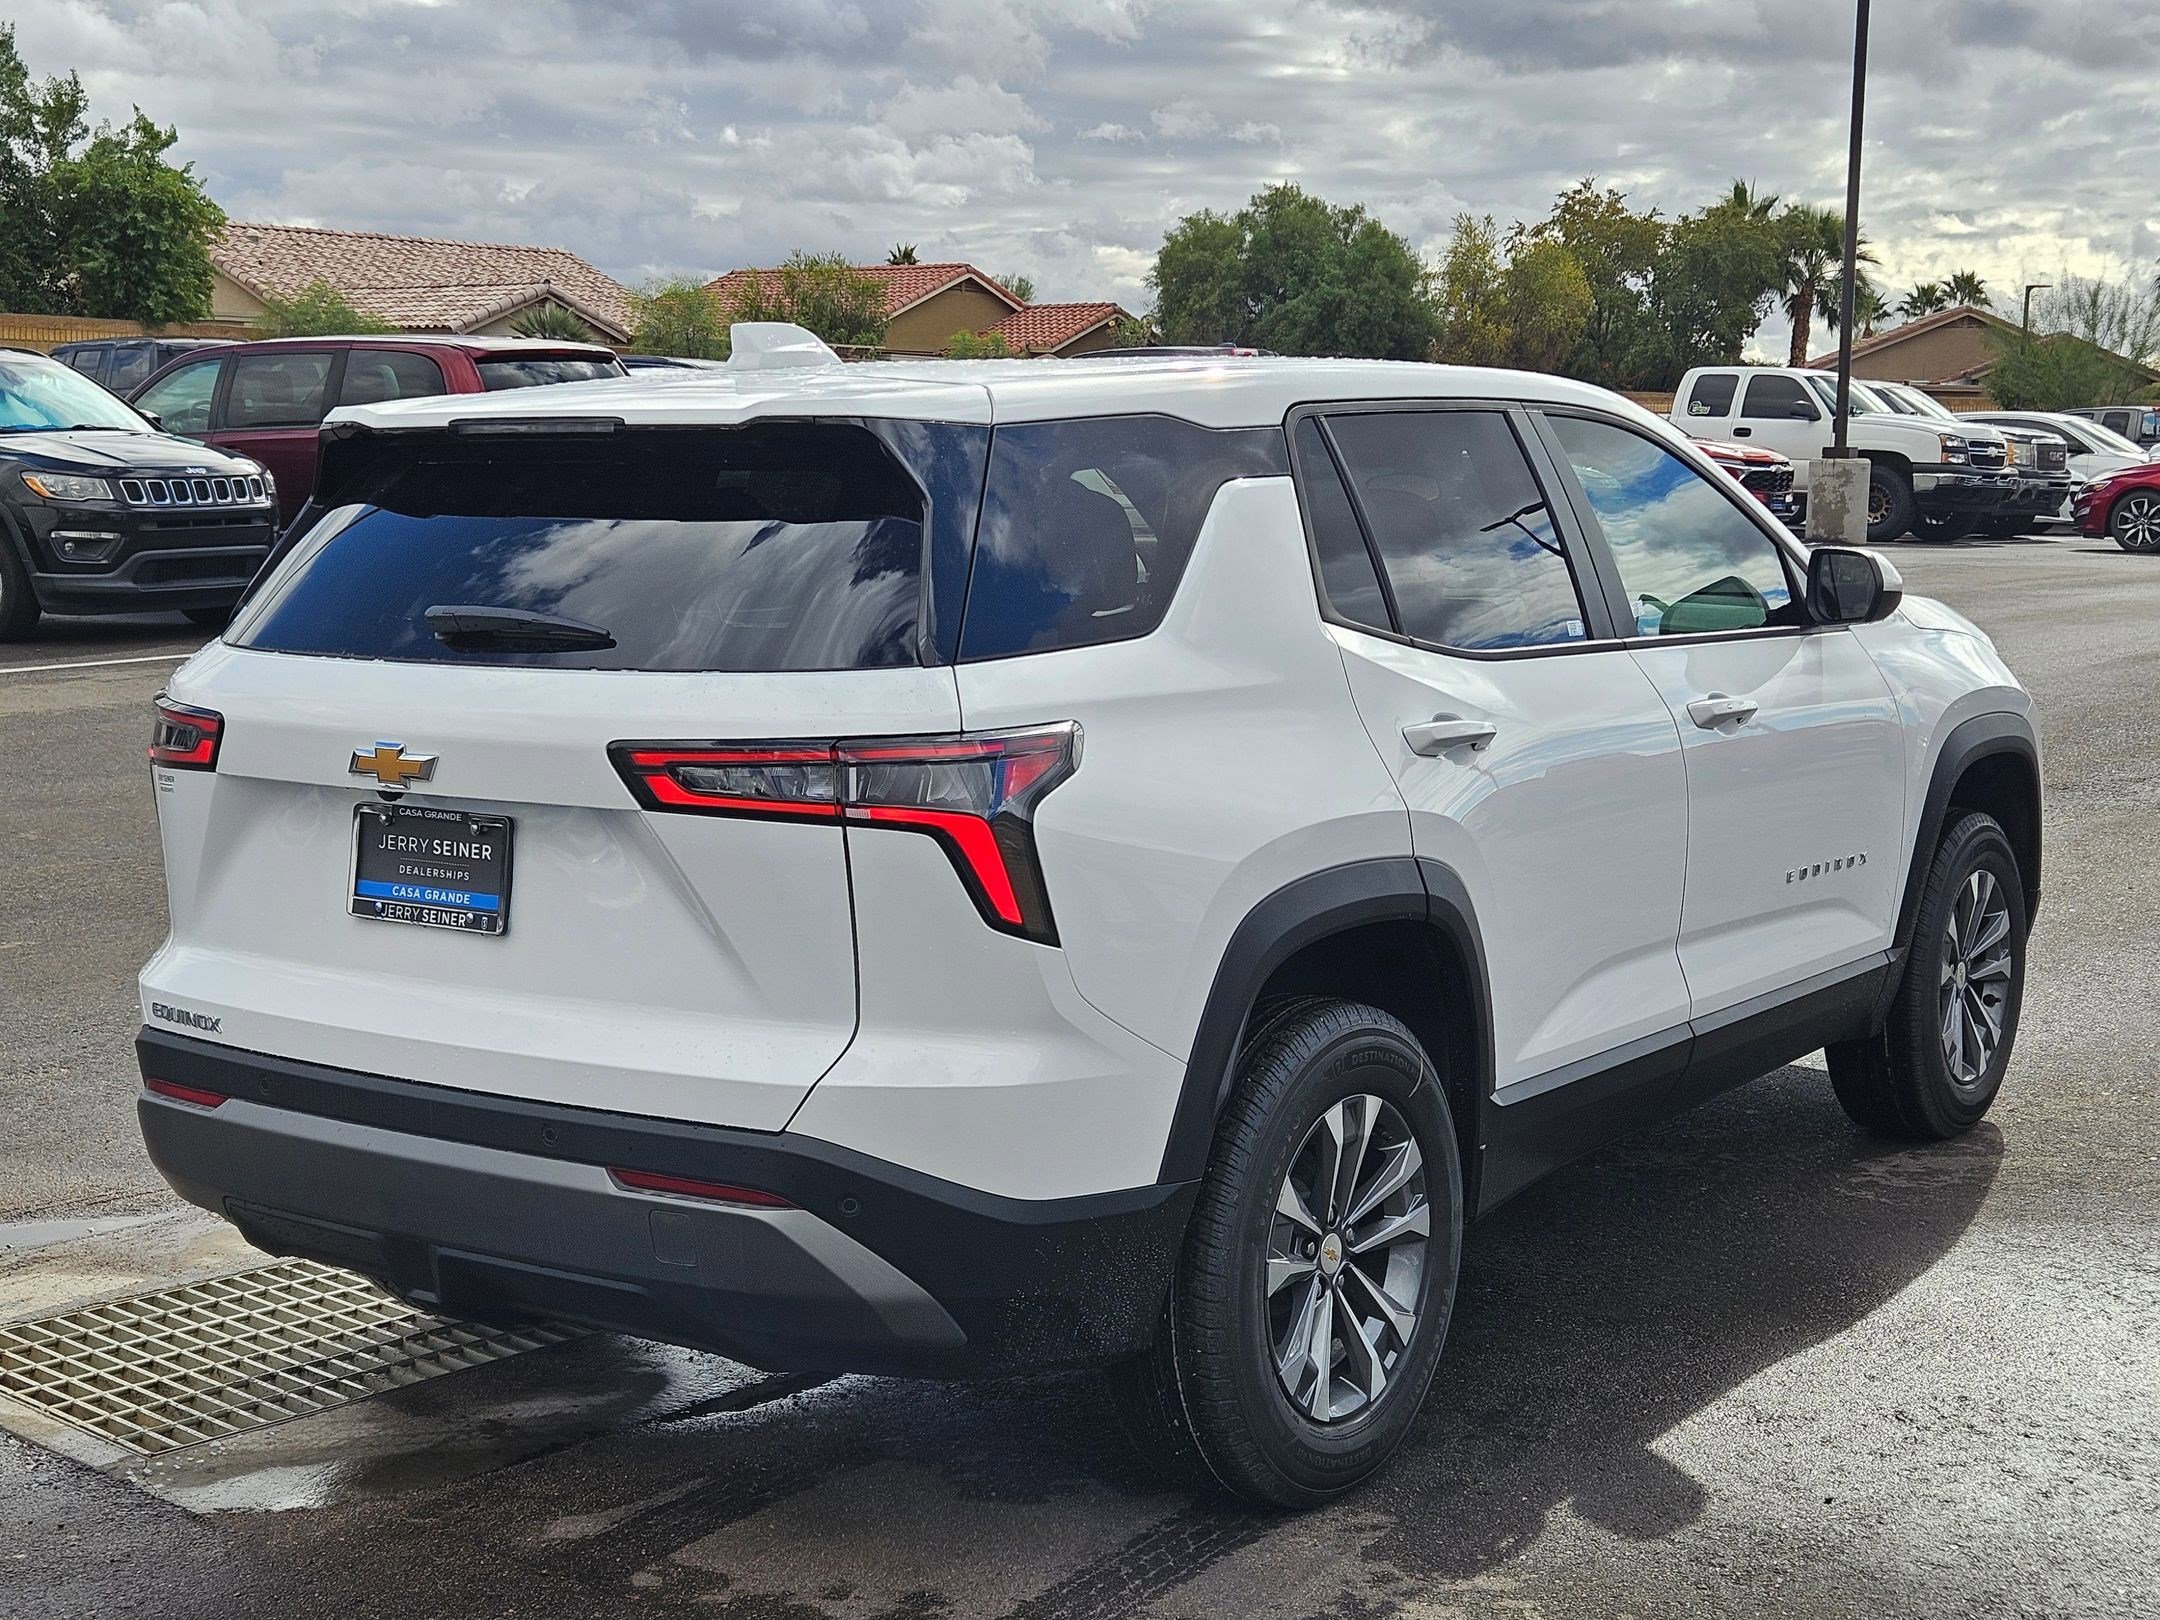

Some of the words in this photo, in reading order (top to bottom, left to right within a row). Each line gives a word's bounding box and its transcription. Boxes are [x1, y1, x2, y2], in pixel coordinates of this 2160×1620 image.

[399, 807, 423, 818] CASA
[424, 810, 462, 822] GRANDE
[378, 834, 429, 853] JERRY
[432, 839, 492, 861] SEINER
[399, 864, 470, 881] DEALERSHIPS
[392, 885, 421, 899] CASA
[425, 889, 471, 905] GRANDE
[380, 904, 420, 921] JERRY
[422, 909, 466, 927] SEINER
[152, 1002, 222, 1034] EQUINOX
[1351, 1050, 1413, 1073] DESTINATION
